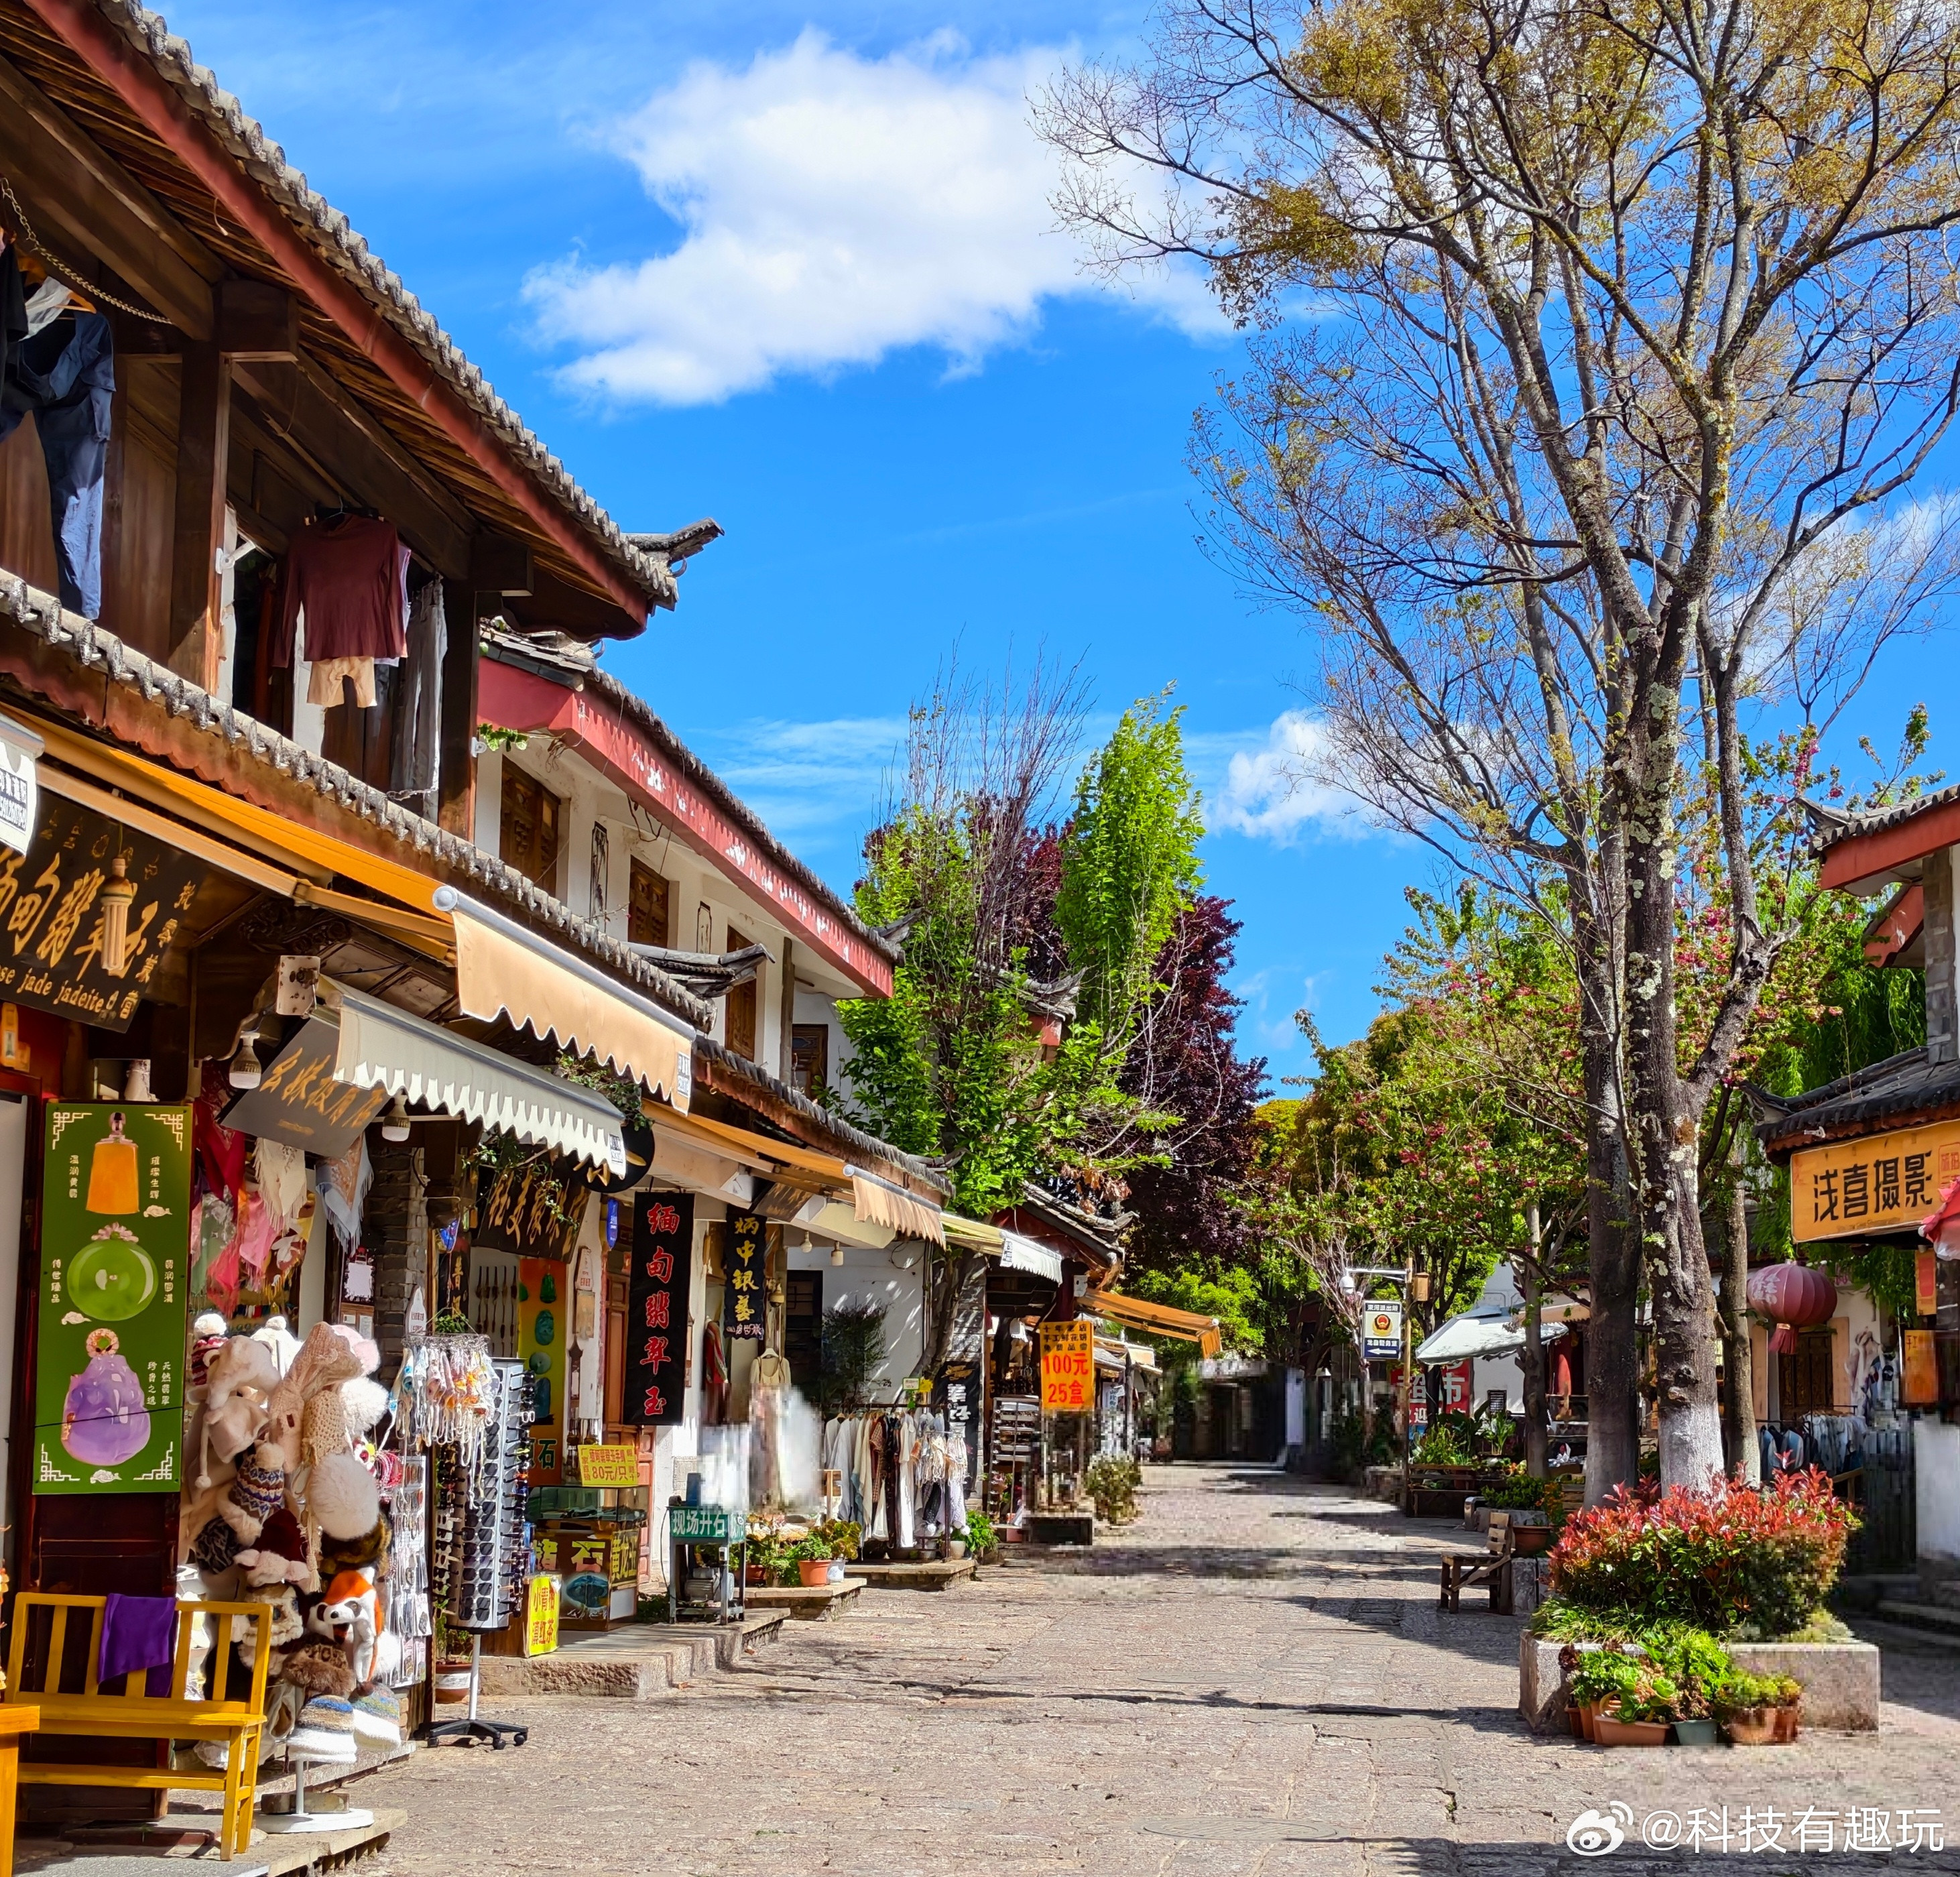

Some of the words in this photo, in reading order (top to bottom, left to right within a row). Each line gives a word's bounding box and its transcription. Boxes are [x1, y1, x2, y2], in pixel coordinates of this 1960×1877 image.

[17, 967, 53, 996] jade
[53, 980, 105, 1013] jadeite
[1813, 1150, 1933, 1223] 浅喜摄影
[639, 1203, 680, 1416] 缅甸翡翠玉
[1043, 1353, 1089, 1376] 100元
[1048, 1380, 1085, 1404] 25盒
[592, 1465, 628, 1481] 80元/只
[673, 1509, 725, 1536] 现场开石
